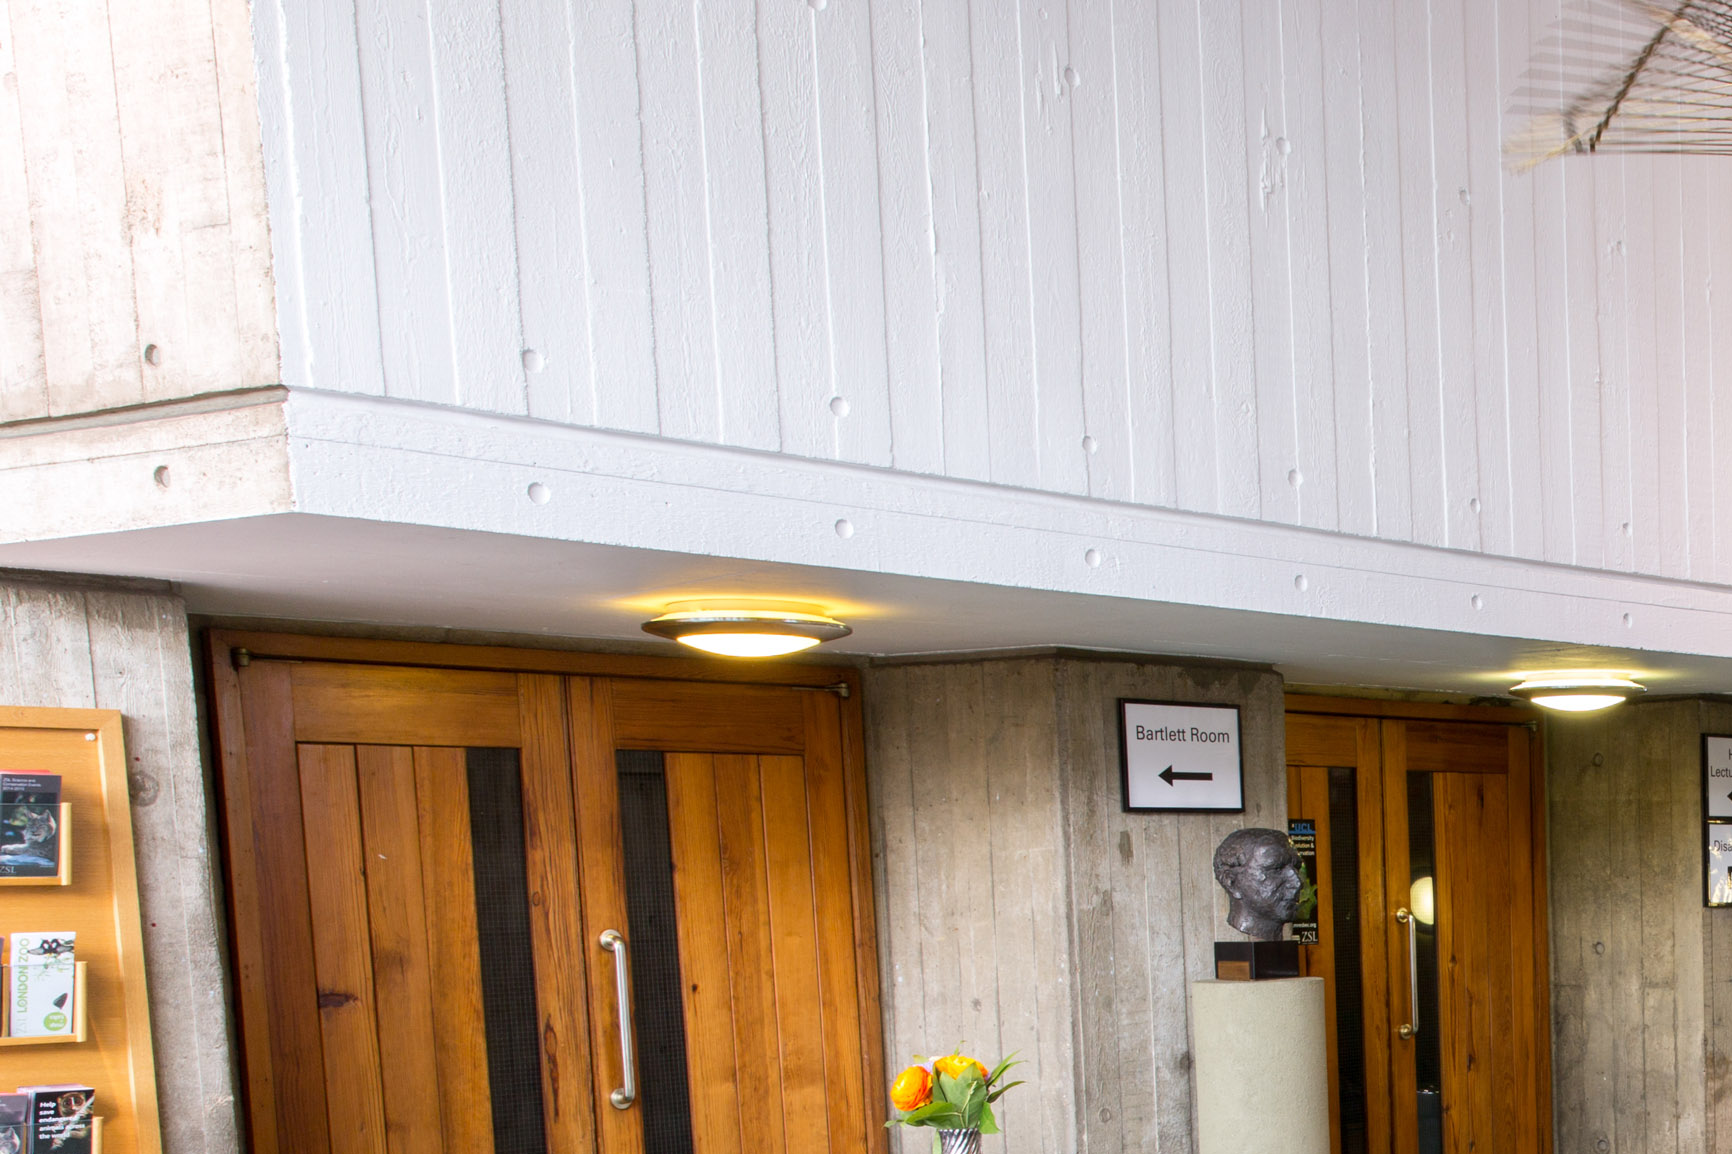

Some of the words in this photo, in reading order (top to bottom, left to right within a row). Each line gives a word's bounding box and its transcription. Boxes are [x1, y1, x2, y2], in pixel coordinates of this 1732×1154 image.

[1136, 725, 1186, 742] Bartlett
[1190, 727, 1230, 743] Room
[1301, 931, 1318, 942] ZSL
[18, 938, 31, 963] ZOO
[17, 965, 29, 1013] LONDON
